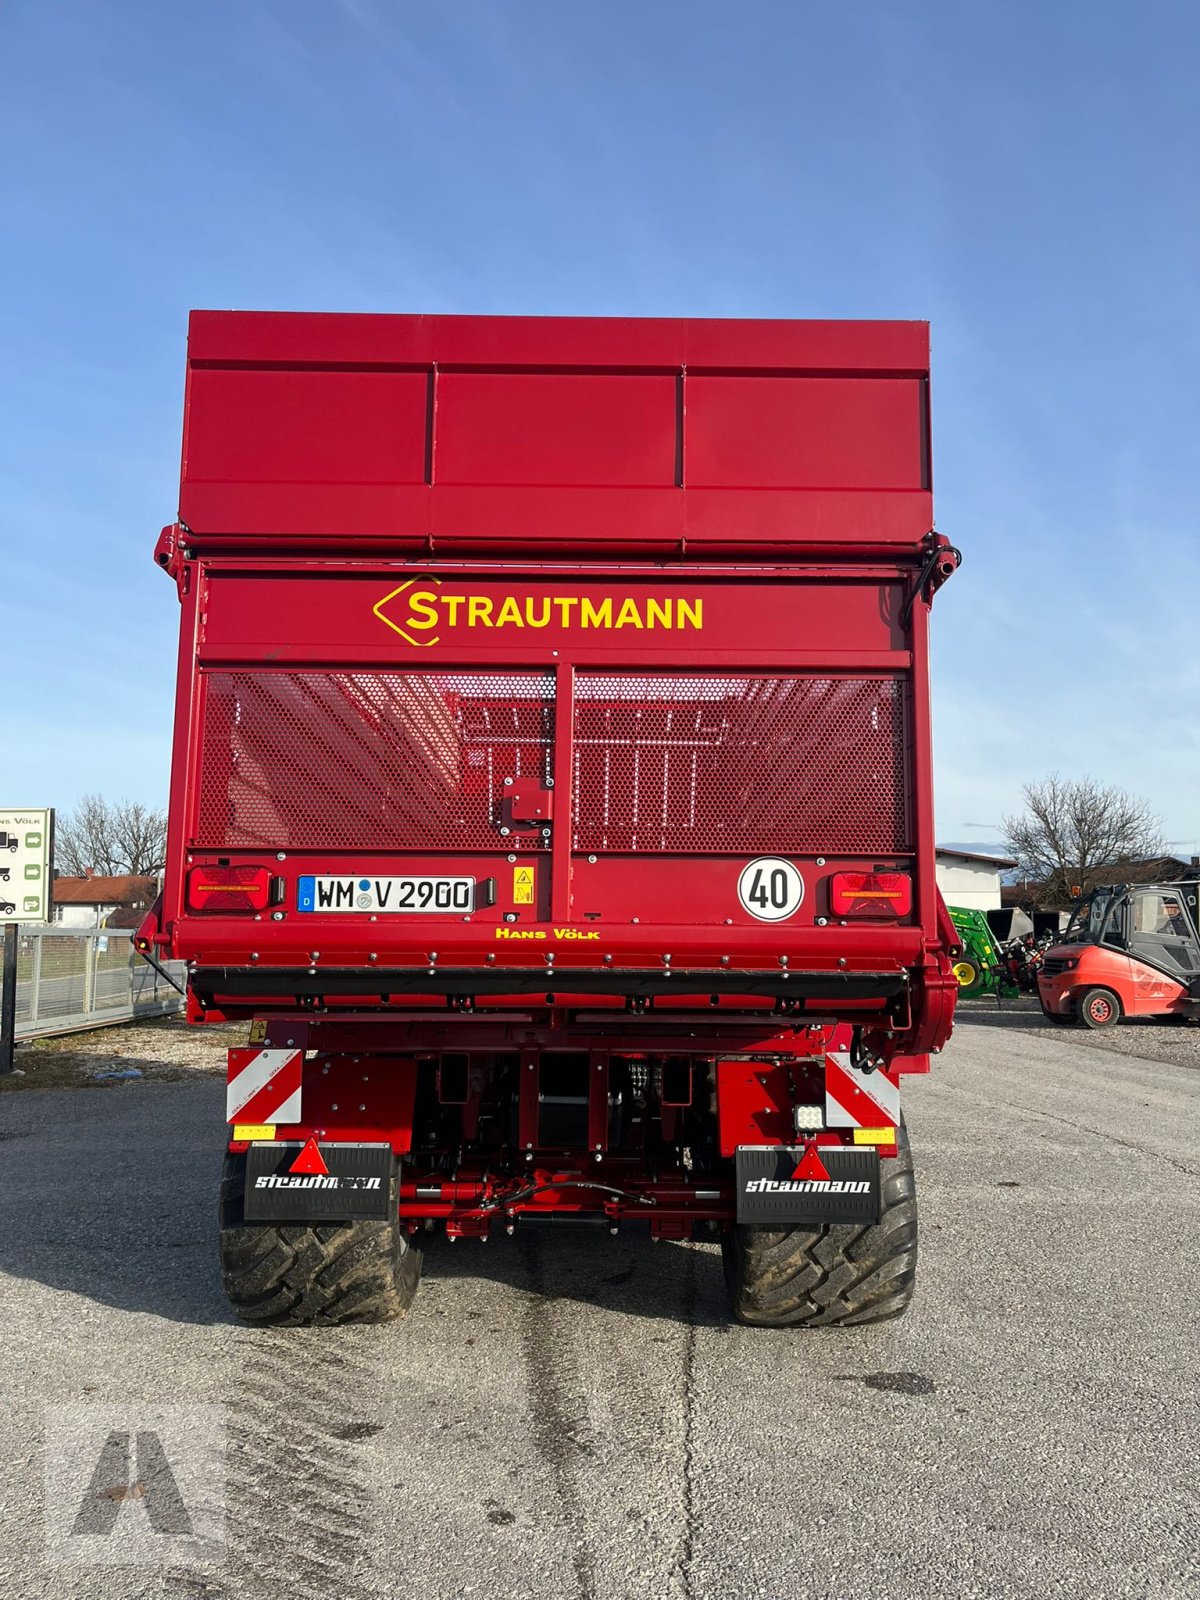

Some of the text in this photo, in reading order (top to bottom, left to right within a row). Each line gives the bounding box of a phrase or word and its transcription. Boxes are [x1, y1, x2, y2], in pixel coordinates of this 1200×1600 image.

[406, 591, 703, 630] STRAUTMANN
[317, 881, 470, 908] WM V 2900
[749, 868, 788, 909] 40
[303, 897, 310, 906] D
[495, 928, 601, 940] HANS VÖLK
[255, 1174, 381, 1189] strautmn
[745, 1178, 871, 1193] strautmann
